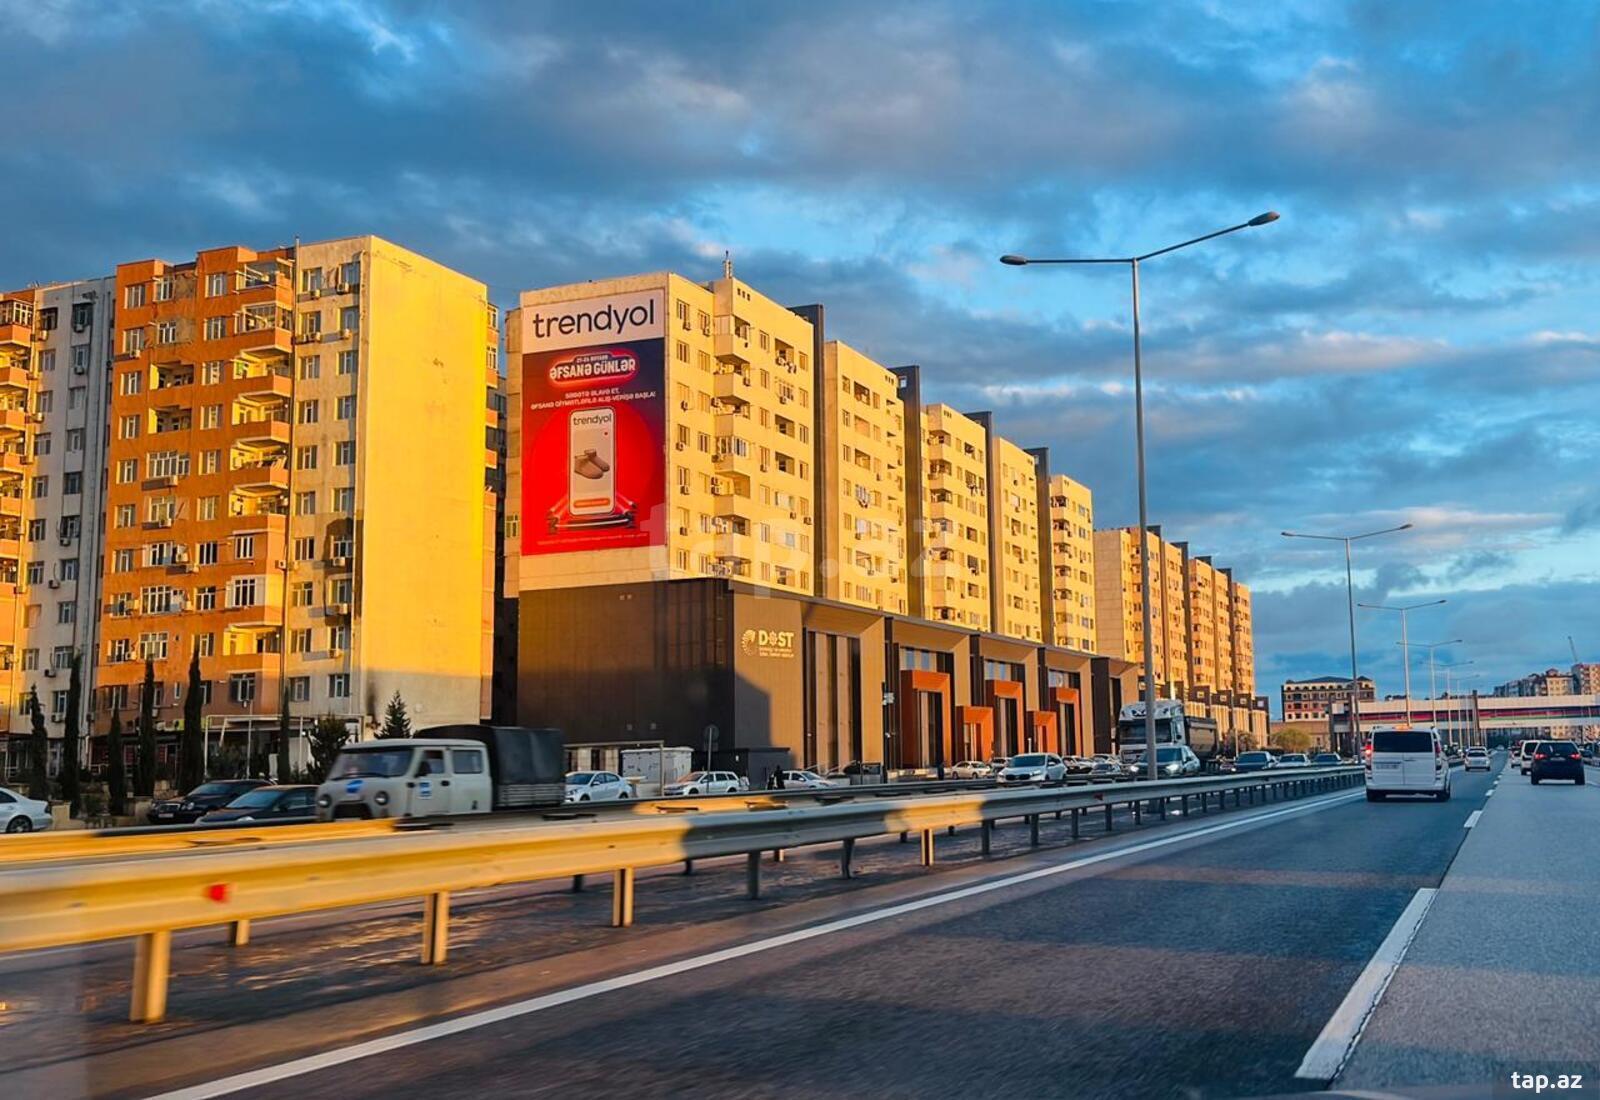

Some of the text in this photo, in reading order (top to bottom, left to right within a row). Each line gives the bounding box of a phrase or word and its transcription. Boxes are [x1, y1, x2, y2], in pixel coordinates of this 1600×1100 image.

[533, 299, 655, 339] trendyol
[549, 363, 593, 380] ƏFSANƏ
[593, 358, 636, 376] GÜNLƏR
[573, 414, 612, 425] trendyol
